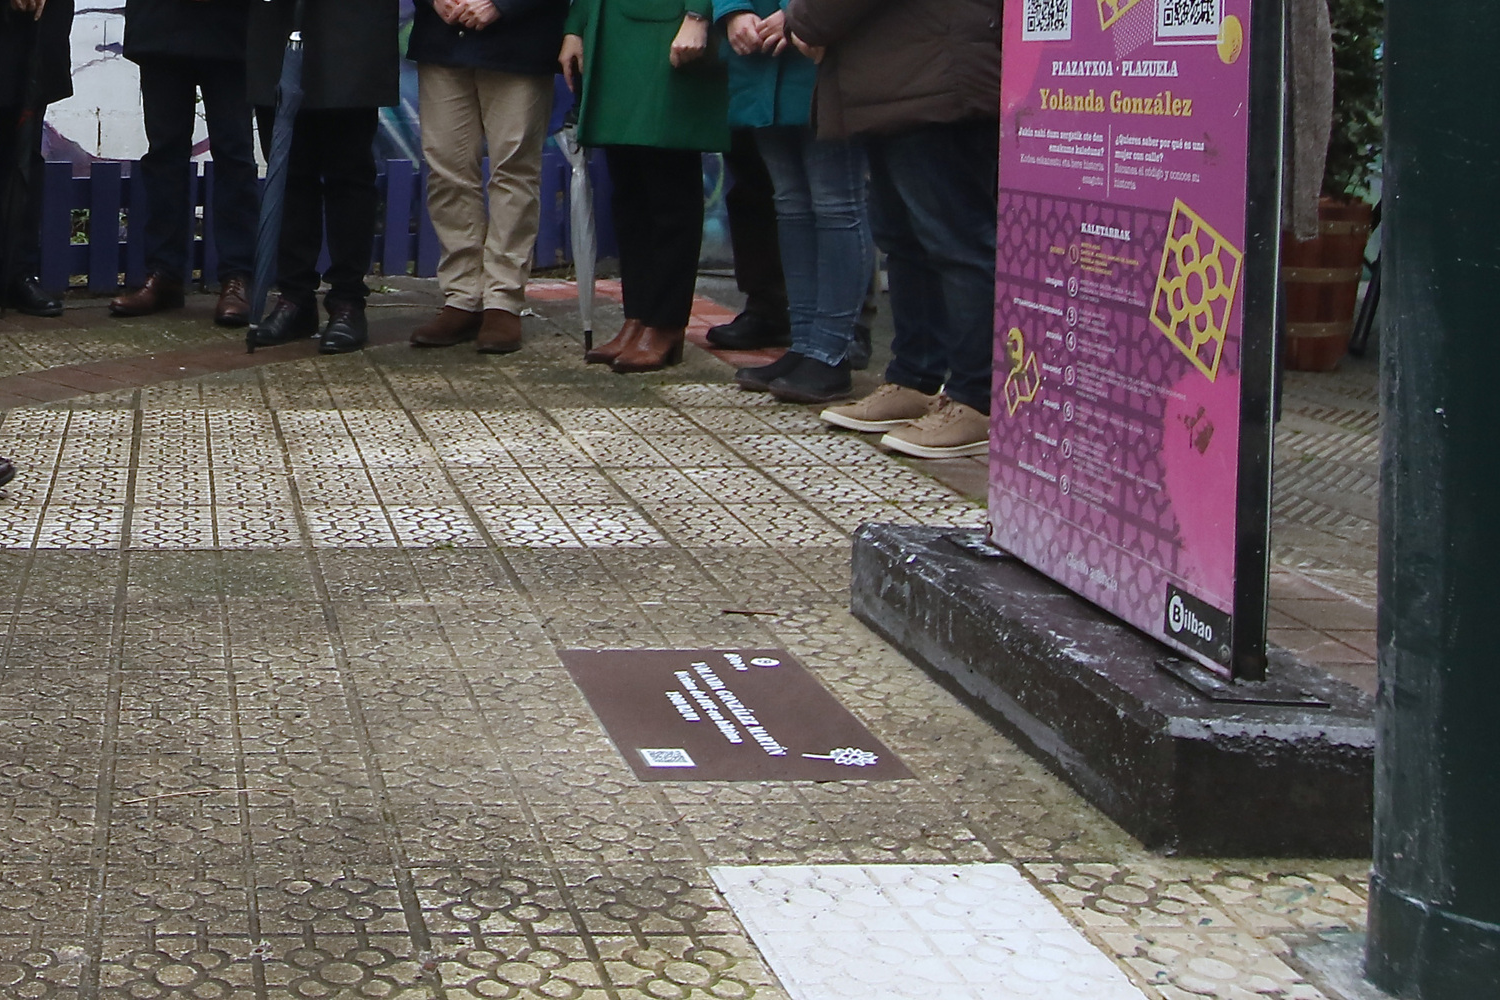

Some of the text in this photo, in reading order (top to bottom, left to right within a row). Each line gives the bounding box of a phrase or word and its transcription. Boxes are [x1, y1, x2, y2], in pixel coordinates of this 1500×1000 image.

[1052, 60, 1178, 76] PLAZATXOA PLAZUELA
[1039, 88, 1192, 116] Yolanda González
[1049, 144, 1074, 154] emakume
[1115, 134, 1205, 150] ¿Quieres saber por qué es una
[1115, 150, 1163, 162] mujer con calle?
[1145, 168, 1163, 179] código
[1164, 170, 1169, 180] y
[1170, 171, 1191, 182] conoce
[1081, 223, 1130, 240] KALETARRAK
[1169, 595, 1212, 641] Bilbao
[691, 662, 788, 755] YOLANDA GONZÁLEZ MARTÍN
